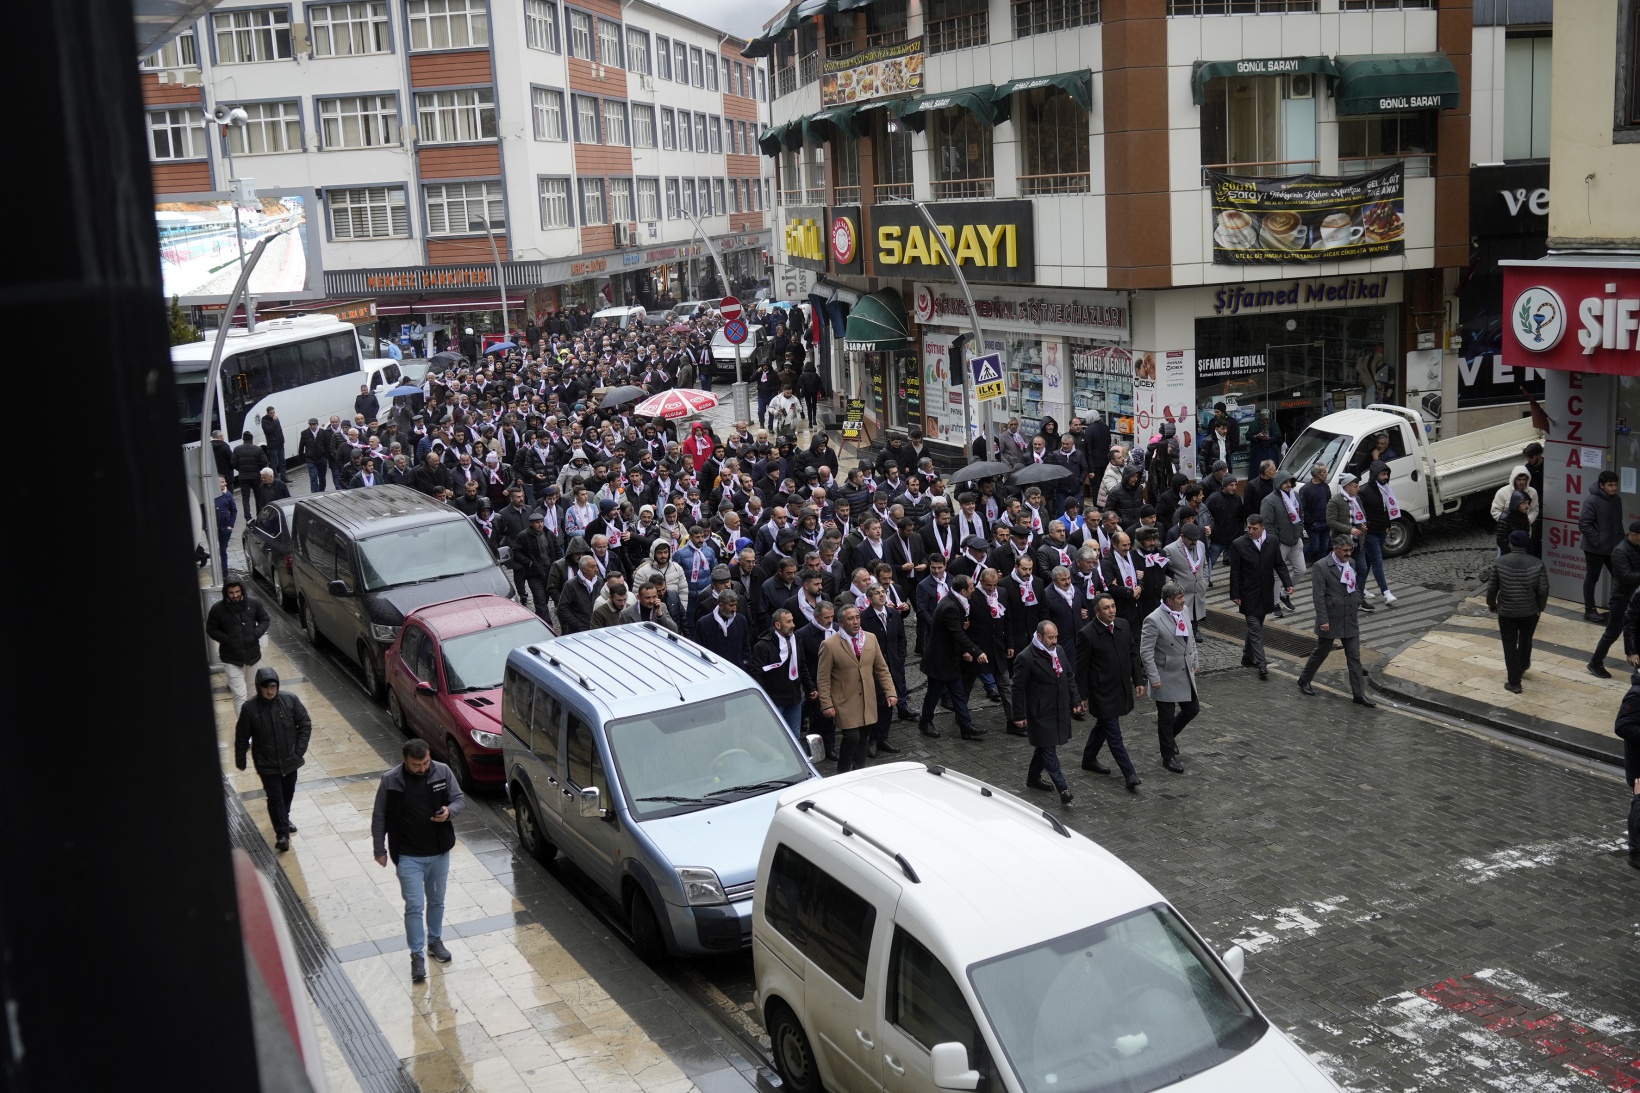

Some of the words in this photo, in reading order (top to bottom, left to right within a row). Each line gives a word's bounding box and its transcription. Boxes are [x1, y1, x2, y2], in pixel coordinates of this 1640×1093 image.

[1237, 61, 1266, 73] GÖNÜL
[1267, 60, 1298, 71] SARAYI
[1379, 97, 1409, 109] GÖNÜL
[1410, 96, 1441, 107] SARAYI
[1366, 180, 1378, 189] GEL
[1381, 184, 1399, 195] AWAY
[1303, 190, 1330, 201] Kahve
[786, 218, 823, 261] GÖNÜL
[878, 224, 1017, 268] SARAYI
[367, 274, 415, 288] MERKEZ
[423, 269, 490, 287] ŞARKÜTERİ
[1214, 283, 1300, 315] Şifamed
[1304, 277, 1388, 303] Medikal
[1018, 303, 1027, 320] &
[1028, 301, 1062, 325] İŞİTME
[1064, 302, 1123, 329] CİHAZLARI
[1578, 283, 1640, 354] ŞİF
[849, 342, 876, 351] SARAYI
[925, 341, 945, 357] İŞİTME
[1104, 357, 1133, 376] MEDİKAL
[1198, 357, 1231, 372] ŞİFAMED
[1232, 354, 1266, 368] MEDİKAL
[978, 384, 994, 395] İLK
[1133, 377, 1155, 389] WIDEX
[698, 402, 713, 410] ALGIDA
[1566, 371, 1584, 522] ECZANE
